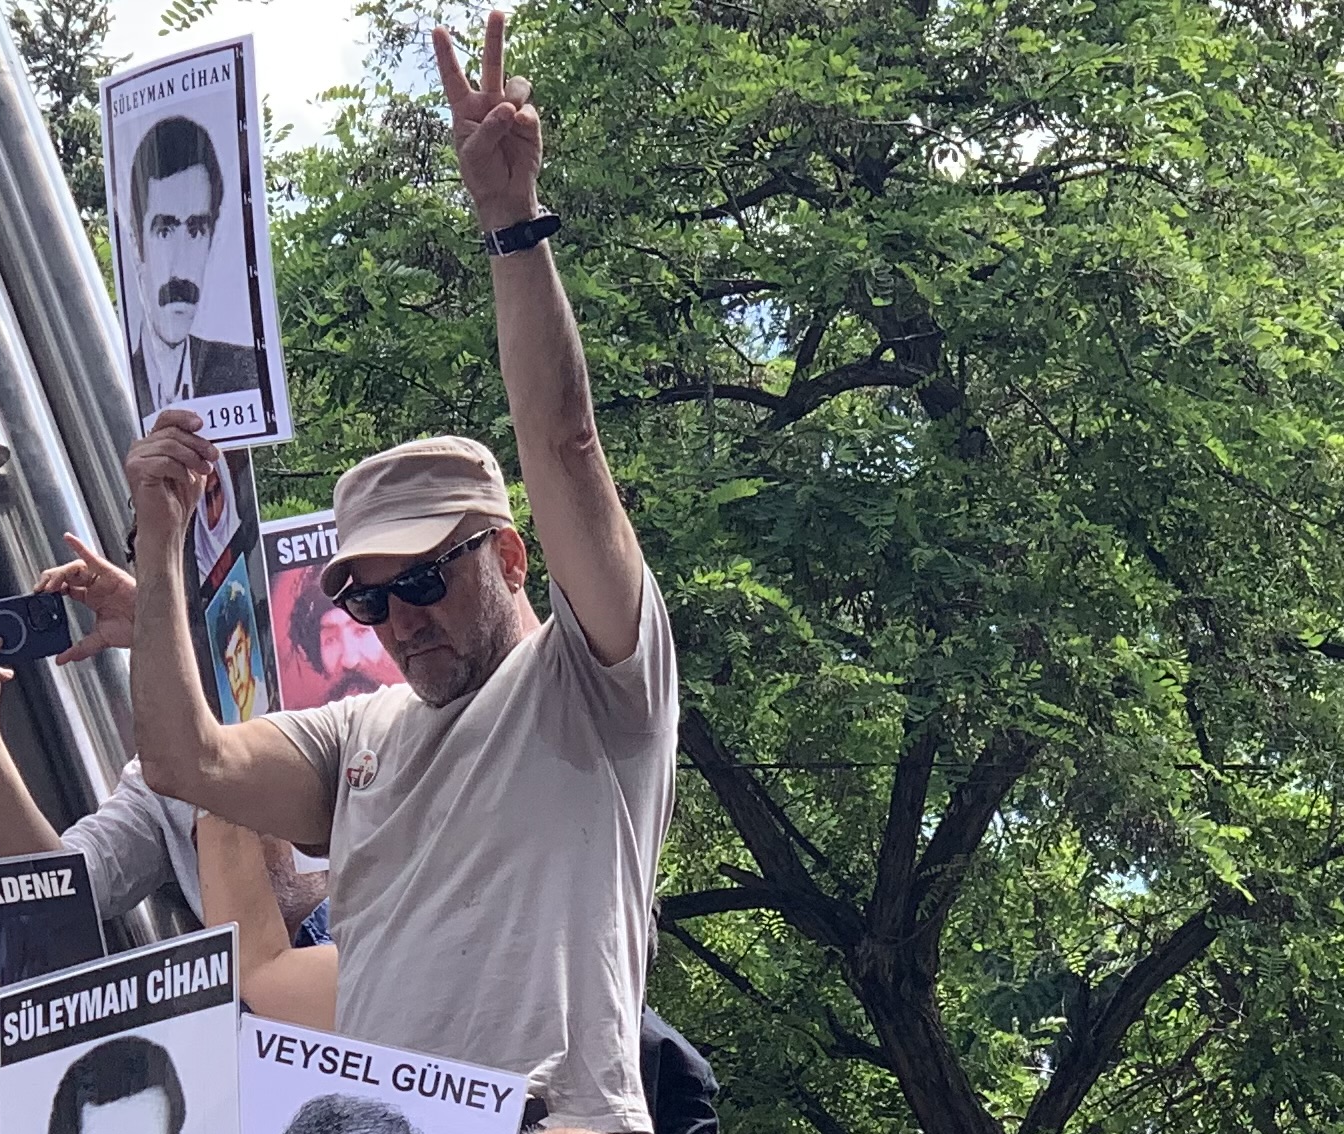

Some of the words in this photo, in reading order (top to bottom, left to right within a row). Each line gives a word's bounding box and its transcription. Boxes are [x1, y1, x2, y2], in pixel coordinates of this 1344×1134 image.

[112, 77, 174, 118] SÜLEYMAN
[181, 62, 231, 93] CİHAN
[207, 403, 258, 429] 1981
[276, 524, 338, 565] SEYİT
[3, 975, 138, 1047] SÜLEYMAN
[146, 951, 229, 1004] CİHAN
[255, 1029, 380, 1086] VEYSEL
[391, 1062, 514, 1113] GÜNEY
